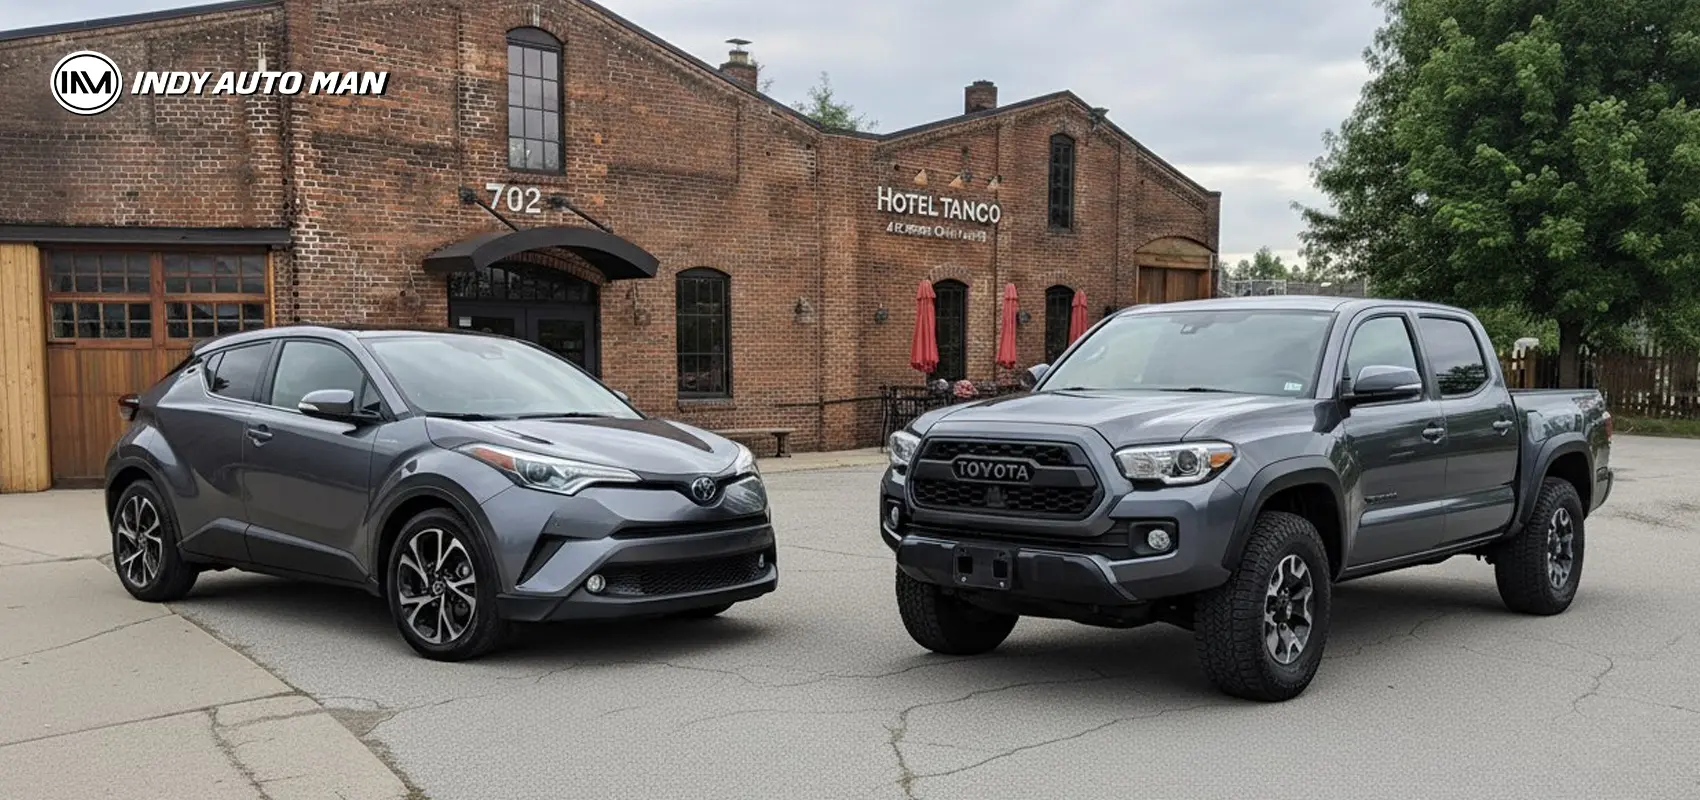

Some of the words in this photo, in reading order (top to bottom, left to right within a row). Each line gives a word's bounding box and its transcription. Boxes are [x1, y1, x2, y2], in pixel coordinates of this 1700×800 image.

[485, 182, 541, 213] 702
[877, 186, 939, 217] HOTEL
[940, 198, 1001, 224] TANCO
[958, 461, 1029, 481] TOYOTA
